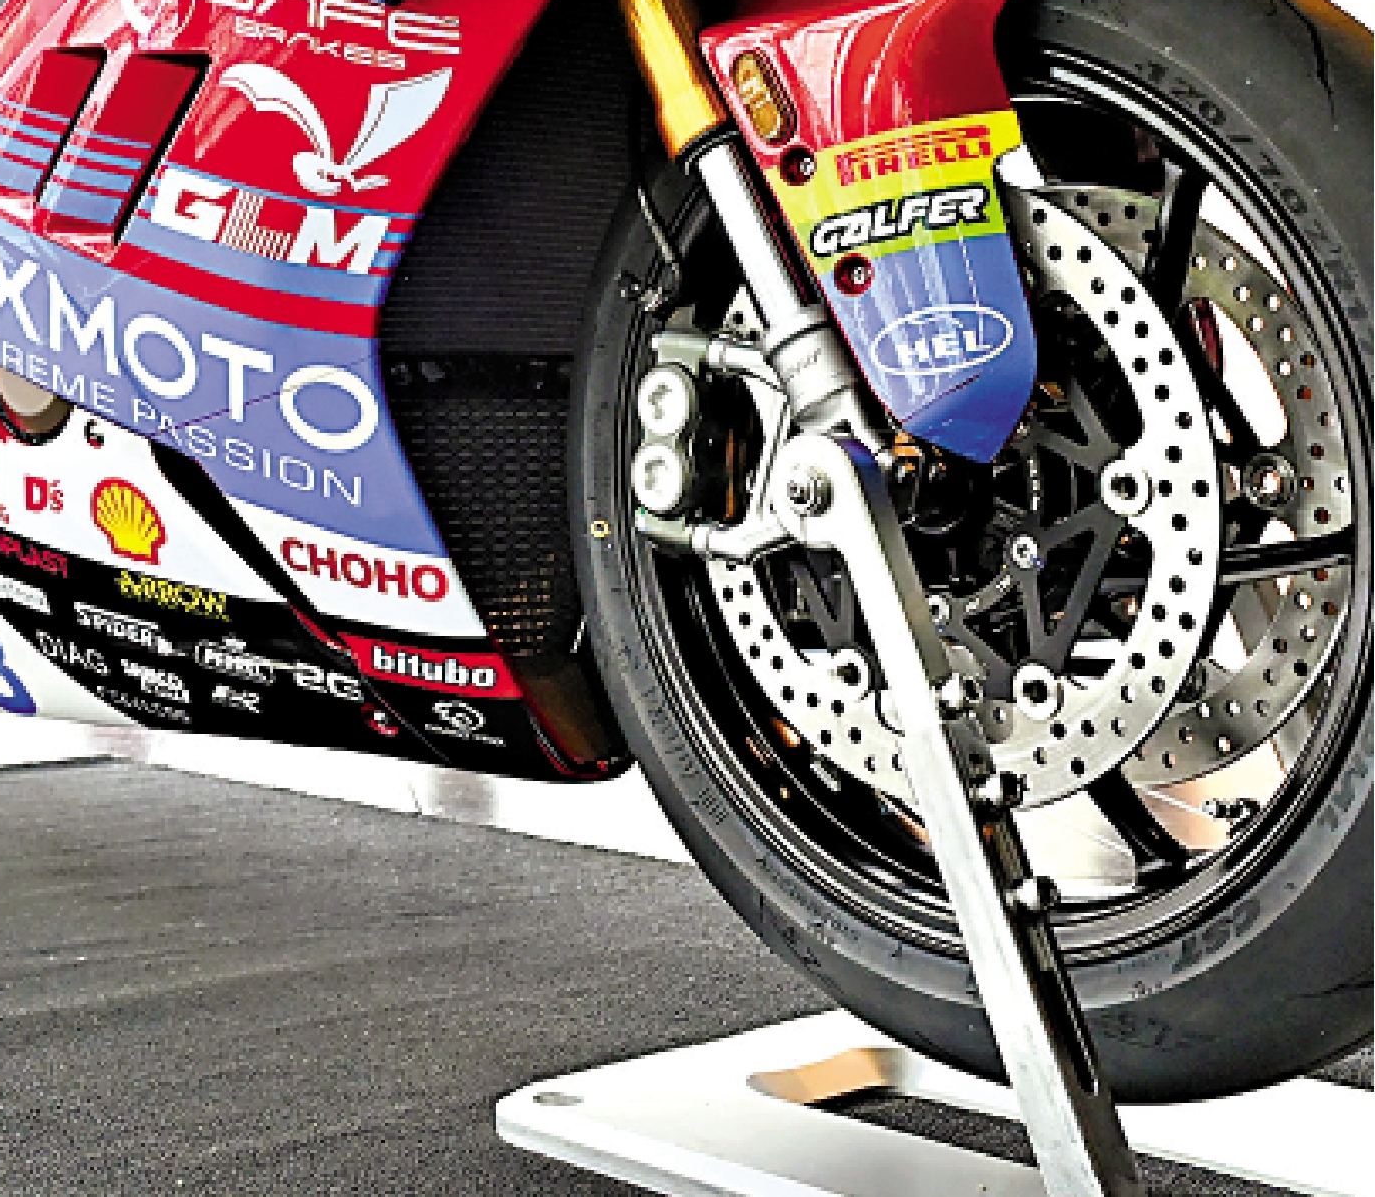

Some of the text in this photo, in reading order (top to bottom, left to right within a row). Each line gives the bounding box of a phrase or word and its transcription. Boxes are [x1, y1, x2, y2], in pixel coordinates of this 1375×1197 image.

[835, 124, 992, 187] PIRELLI
[149, 167, 391, 276] GLM
[895, 329, 992, 365] HEL
[131, 397, 363, 508] PASSION
[279, 535, 451, 604] CHOHO
[371, 645, 497, 689] bitubo
